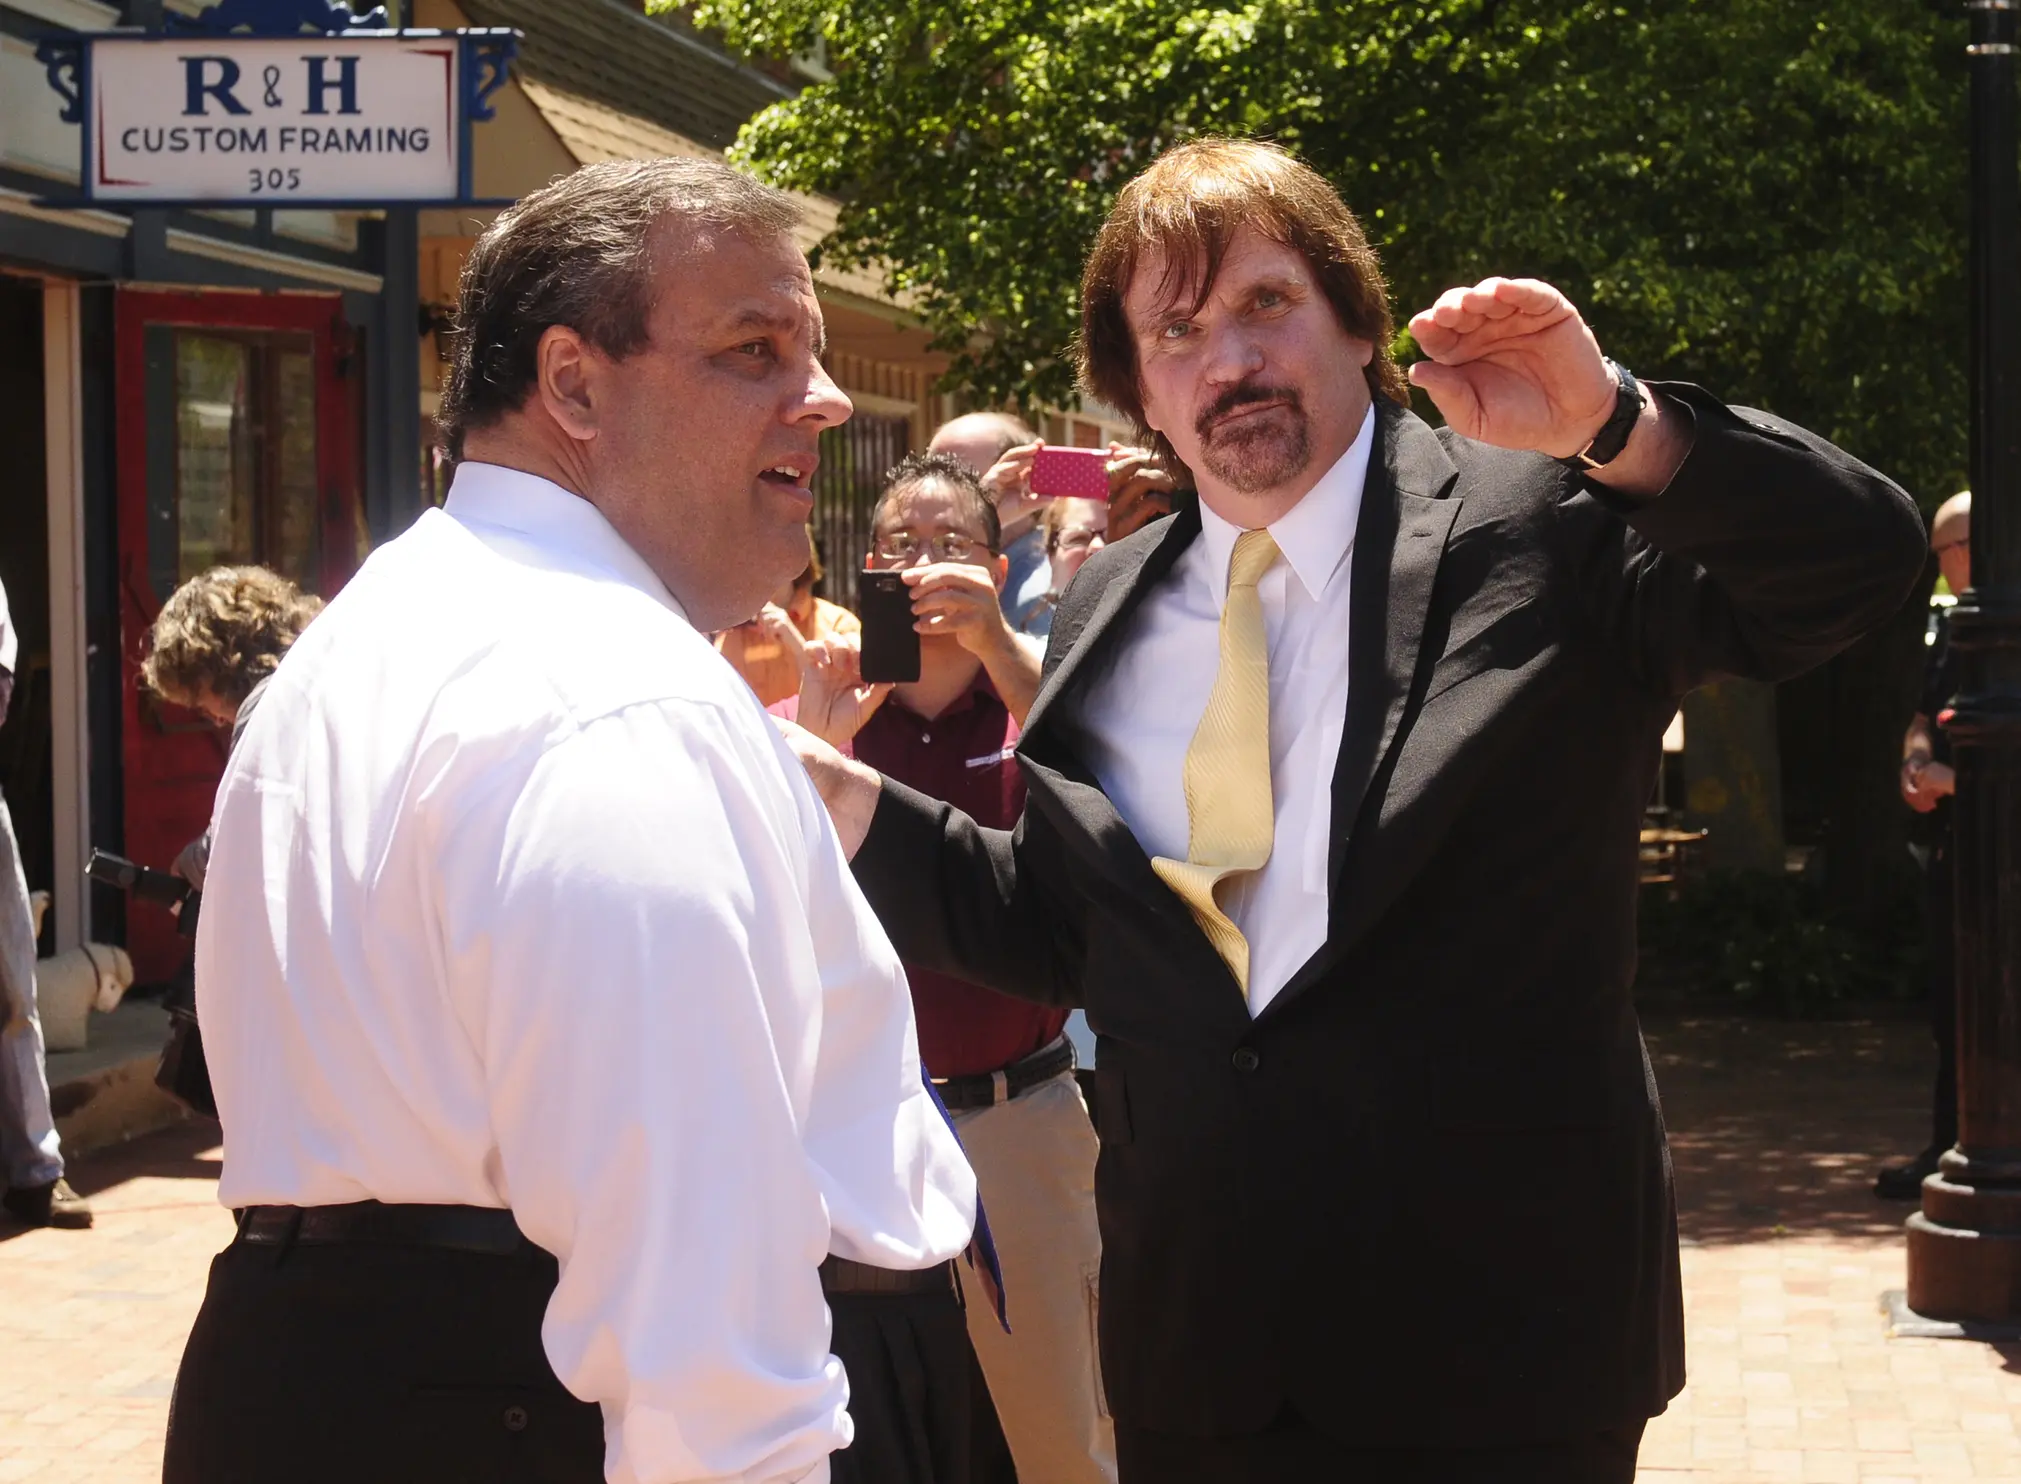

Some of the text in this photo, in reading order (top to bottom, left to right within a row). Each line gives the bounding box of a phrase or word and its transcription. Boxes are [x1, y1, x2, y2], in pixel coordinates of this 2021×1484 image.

[178, 55, 362, 117] R & H
[121, 126, 430, 154] CUSTOM FRAMING
[249, 168, 301, 194] 305
